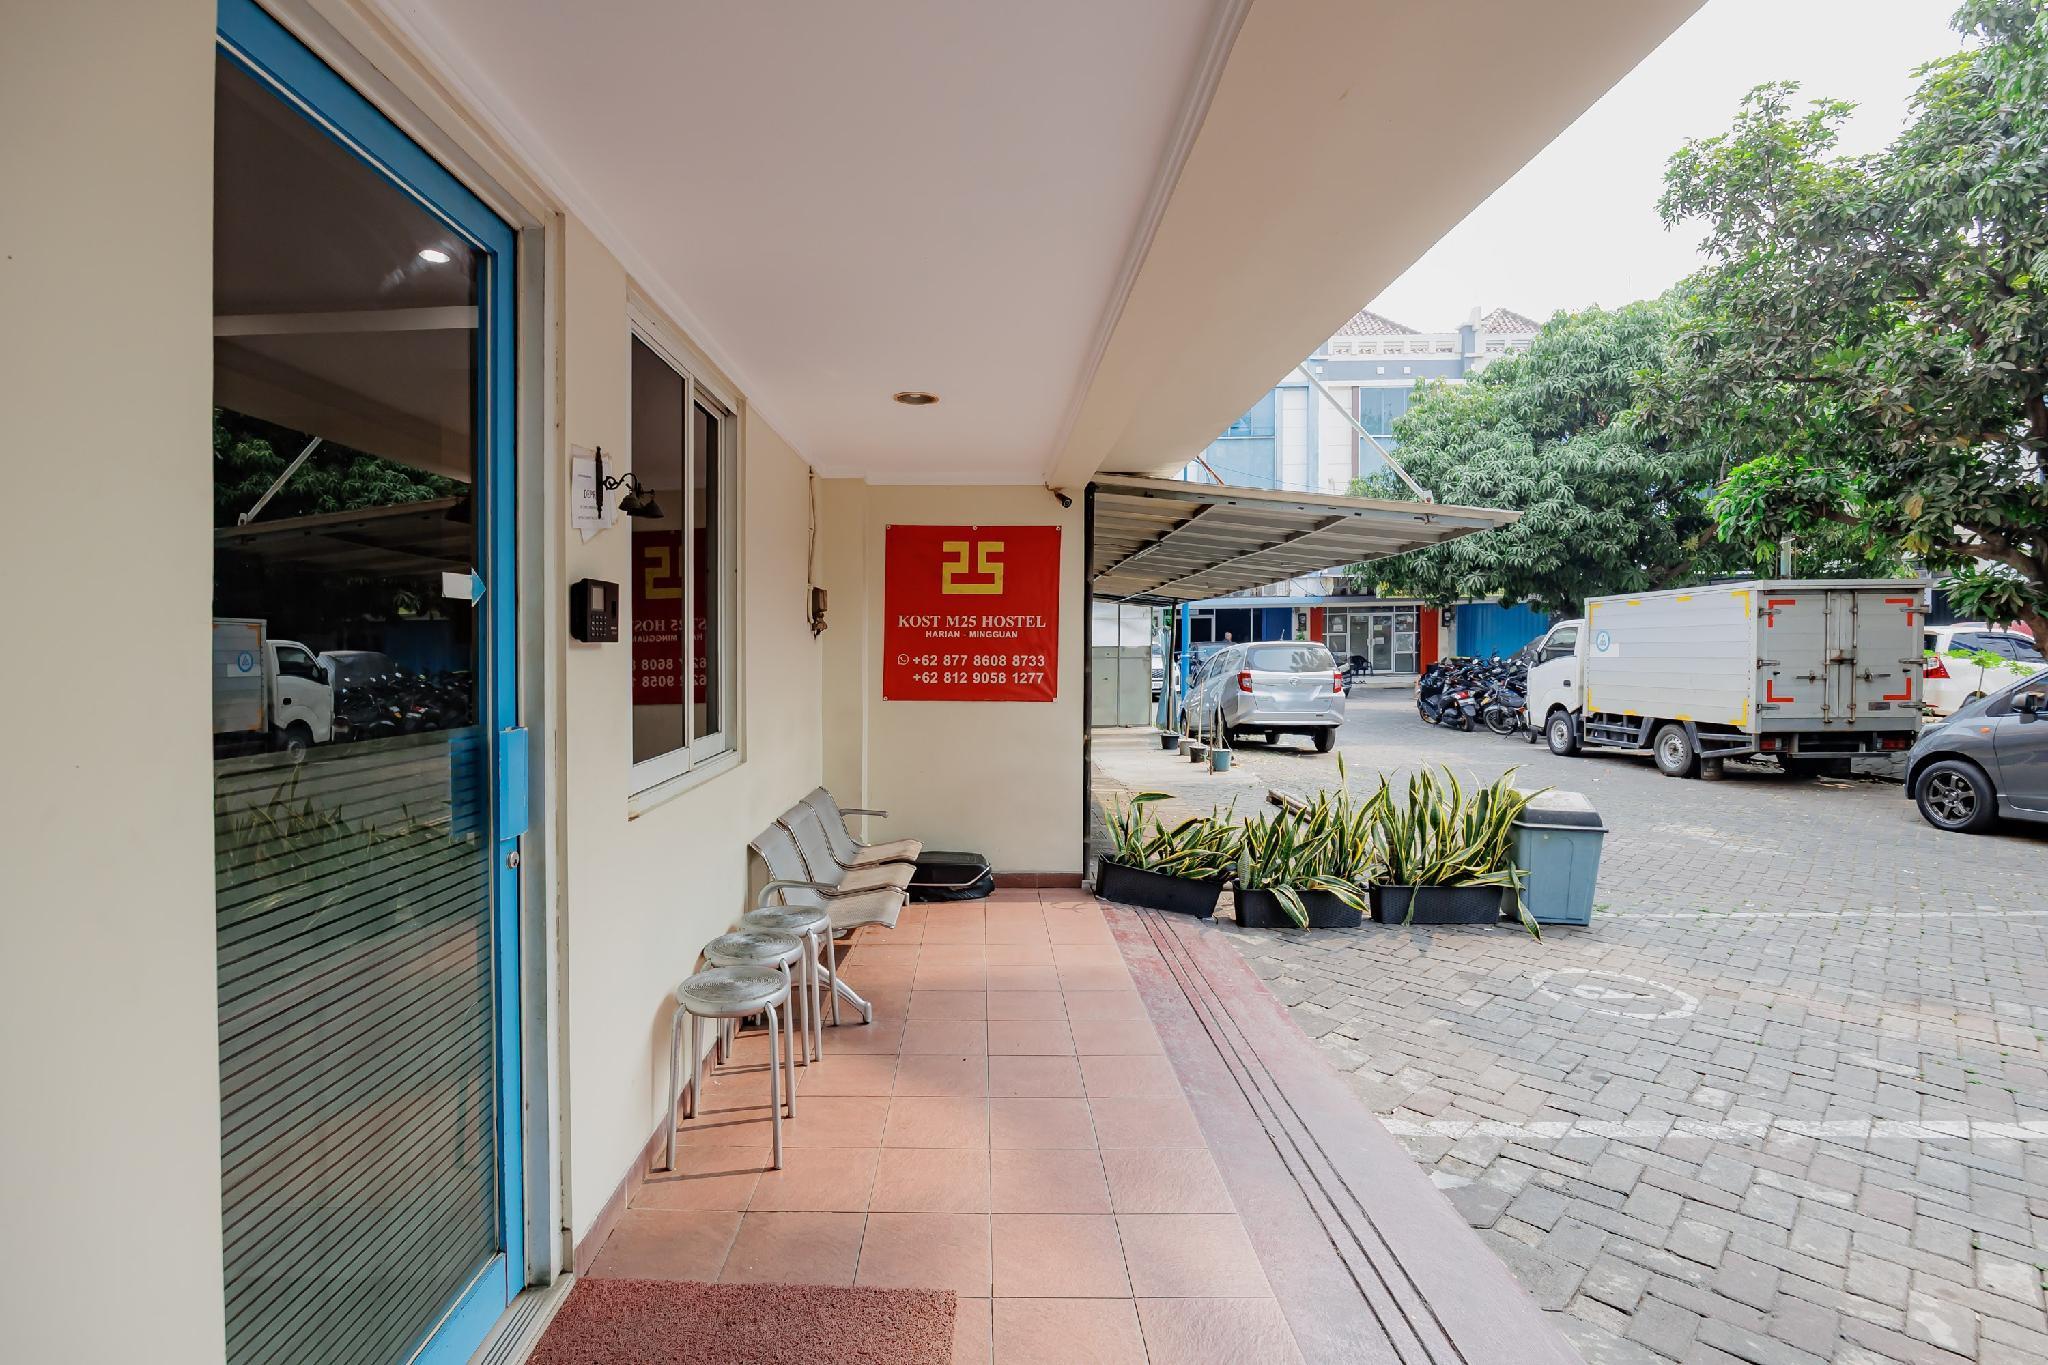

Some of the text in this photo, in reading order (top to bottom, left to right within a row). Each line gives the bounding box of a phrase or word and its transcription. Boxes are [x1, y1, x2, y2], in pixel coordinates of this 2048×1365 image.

[942, 541, 1004, 594] 25
[898, 615, 1046, 628] KOST M25 HOSTEL
[925, 630, 960, 638] HARIAN
[969, 630, 1018, 638] MINGGUAN
[913, 655, 1045, 667] +62 877 8608 8733
[913, 672, 1044, 684] +62 812 9058 1277
